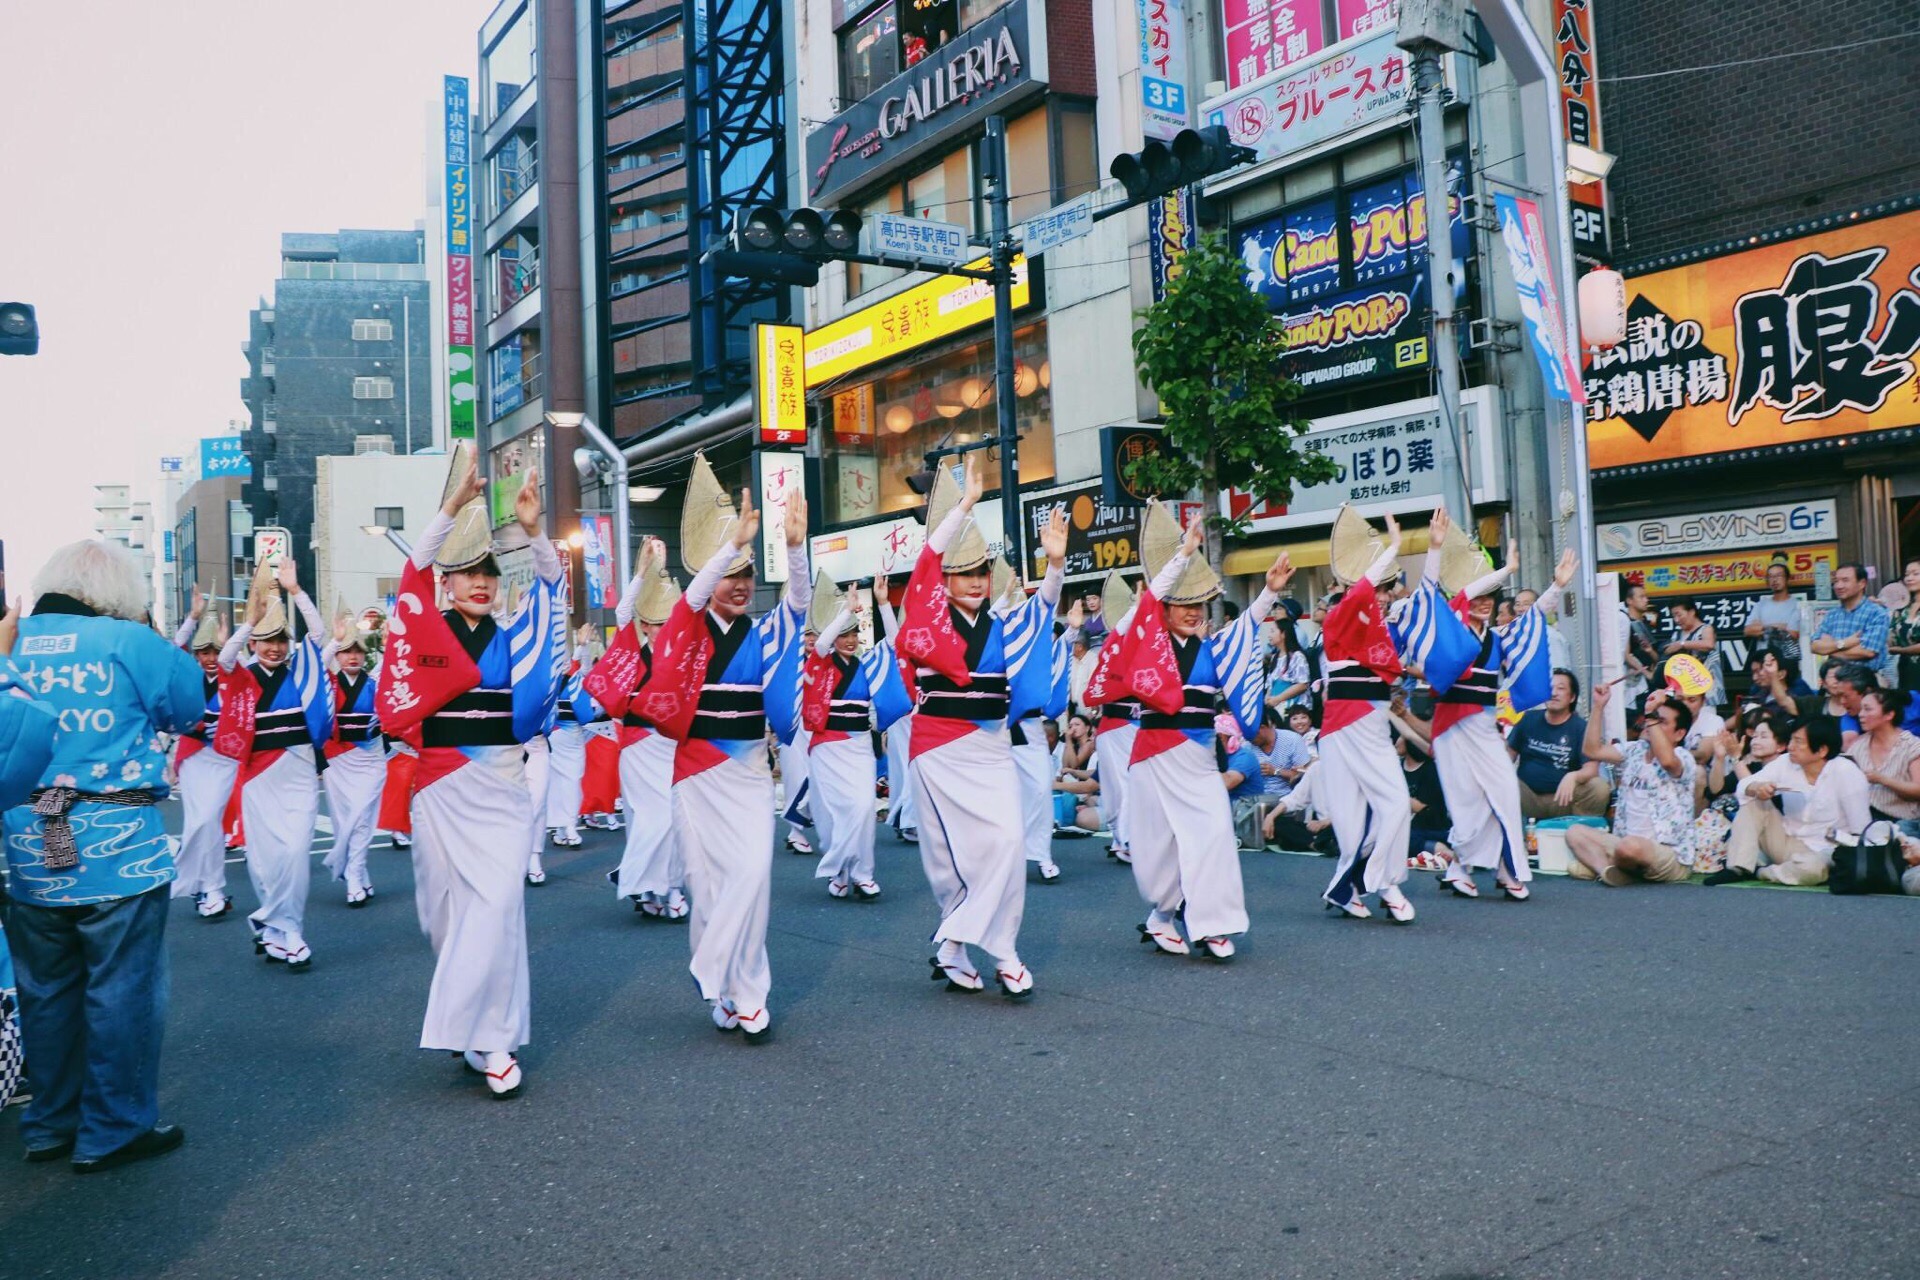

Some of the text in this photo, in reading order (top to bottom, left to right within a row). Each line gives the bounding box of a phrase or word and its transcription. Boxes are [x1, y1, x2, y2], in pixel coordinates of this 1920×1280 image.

[879, 26, 1020, 139] GALLERIA
[1277, 55, 1356, 98] スクールサロン
[1556, 0, 1590, 147] 八分目
[1149, 82, 1178, 107] 3F
[449, 95, 465, 162] 中央建設
[452, 167, 467, 246] イタリア語
[881, 221, 960, 246] 高円寺駅南口
[1028, 204, 1087, 239] 高円寺駅南口
[1573, 208, 1601, 243] 2F
[886, 239, 957, 257] Koenji Sta. S. Ent.
[452, 257, 468, 334] ワイン教室
[1399, 341, 1424, 361] 2F
[1302, 357, 1376, 385] UPWARD GROUP
[776, 430, 791, 441] 2F
[1350, 480, 1410, 500] 処方せん受付
[1639, 511, 1785, 546] GLOWING
[1790, 506, 1829, 530] 6F
[1064, 555, 1093, 573] ビール
[1678, 561, 1751, 585] ミスチョイス
[1660, 595, 1757, 617] イーネット
[1661, 612, 1745, 632] コクカフ
